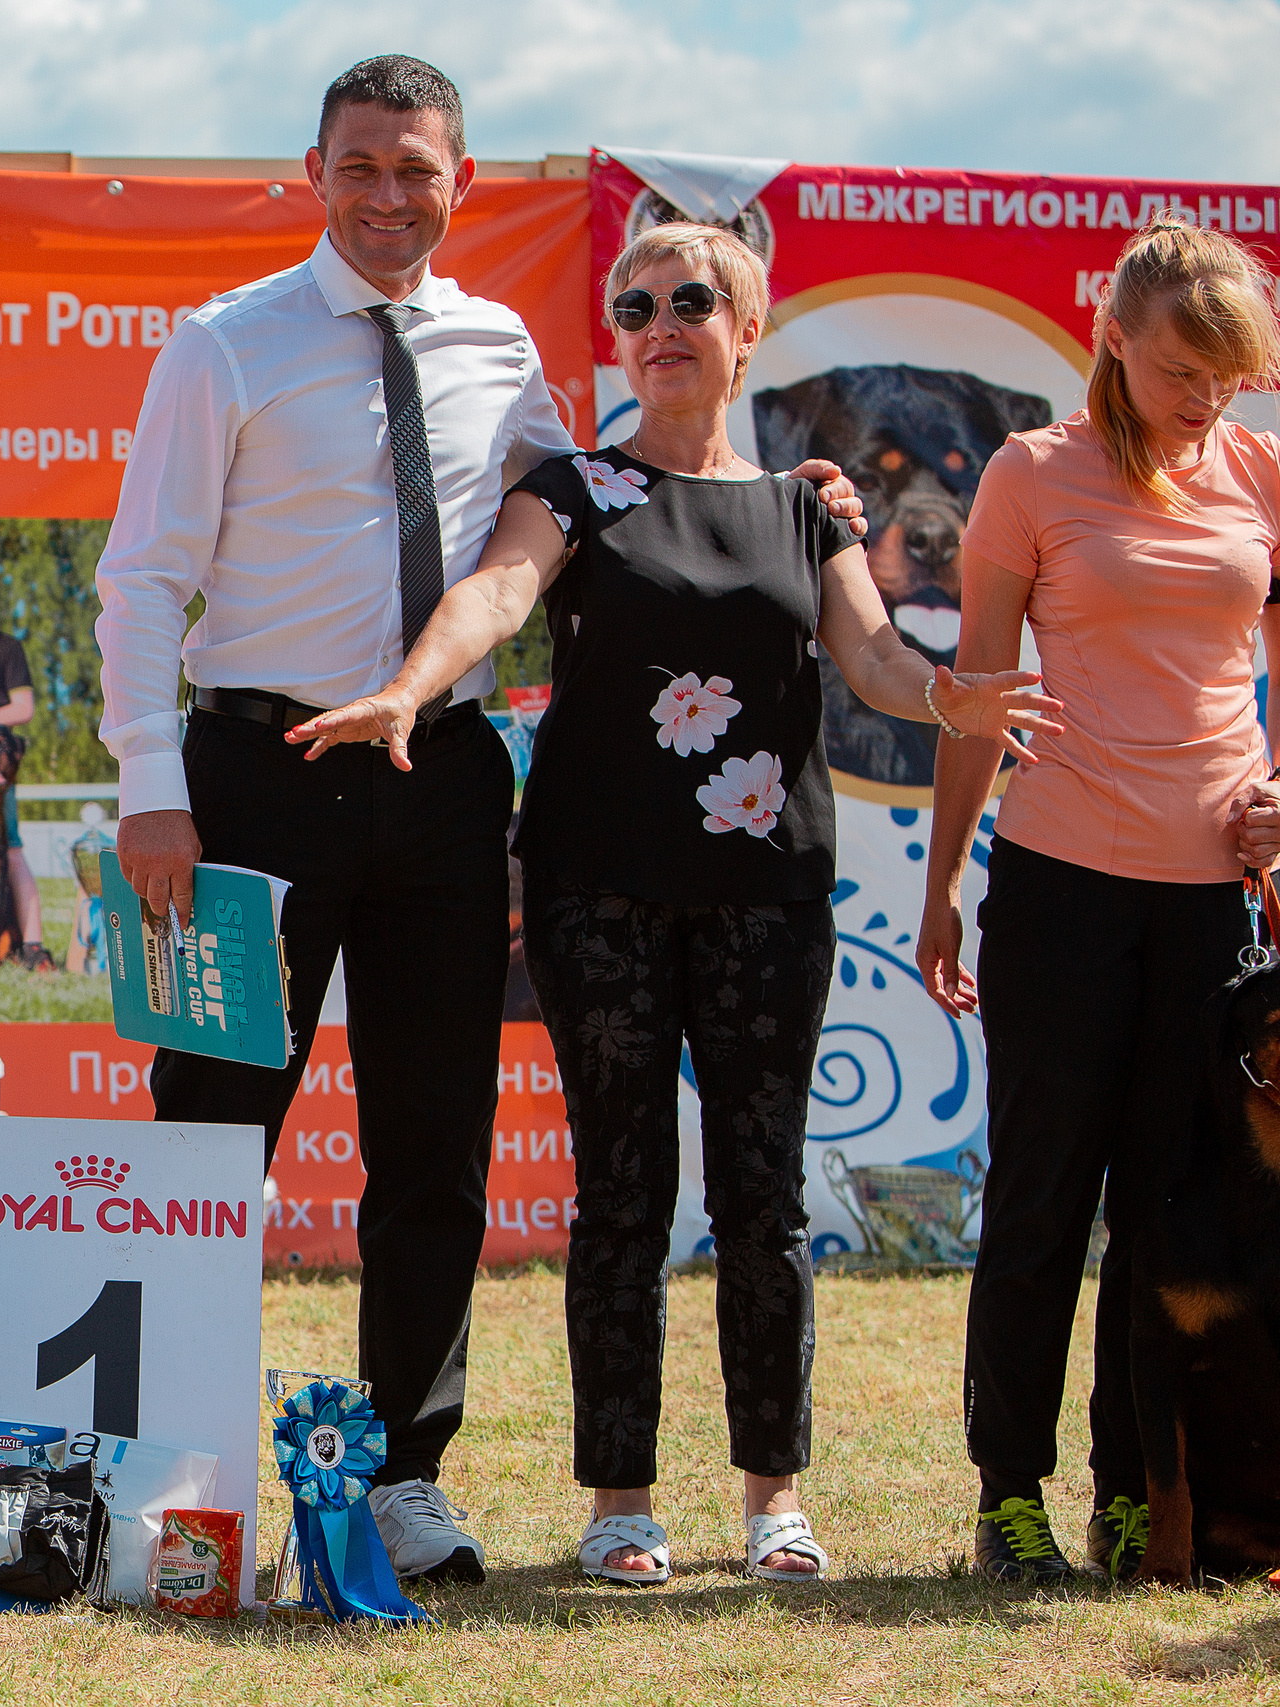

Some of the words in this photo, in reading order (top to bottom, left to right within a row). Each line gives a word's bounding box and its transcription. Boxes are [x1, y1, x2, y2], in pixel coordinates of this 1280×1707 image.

[1075, 269, 1116, 308] К
[115, 930, 126, 981] TABOOSPORT
[148, 954, 158, 987] Silver
[183, 924, 198, 982] Silver
[152, 987, 161, 1011] CUP
[188, 986, 205, 1027] CUP
[96, 1197, 248, 1239] CANIN
[35, 1279, 143, 1440] 1
[196, 1545, 207, 1553] 30
[160, 1578, 186, 1589] Körner
[187, 1576, 201, 1588] Dr.
